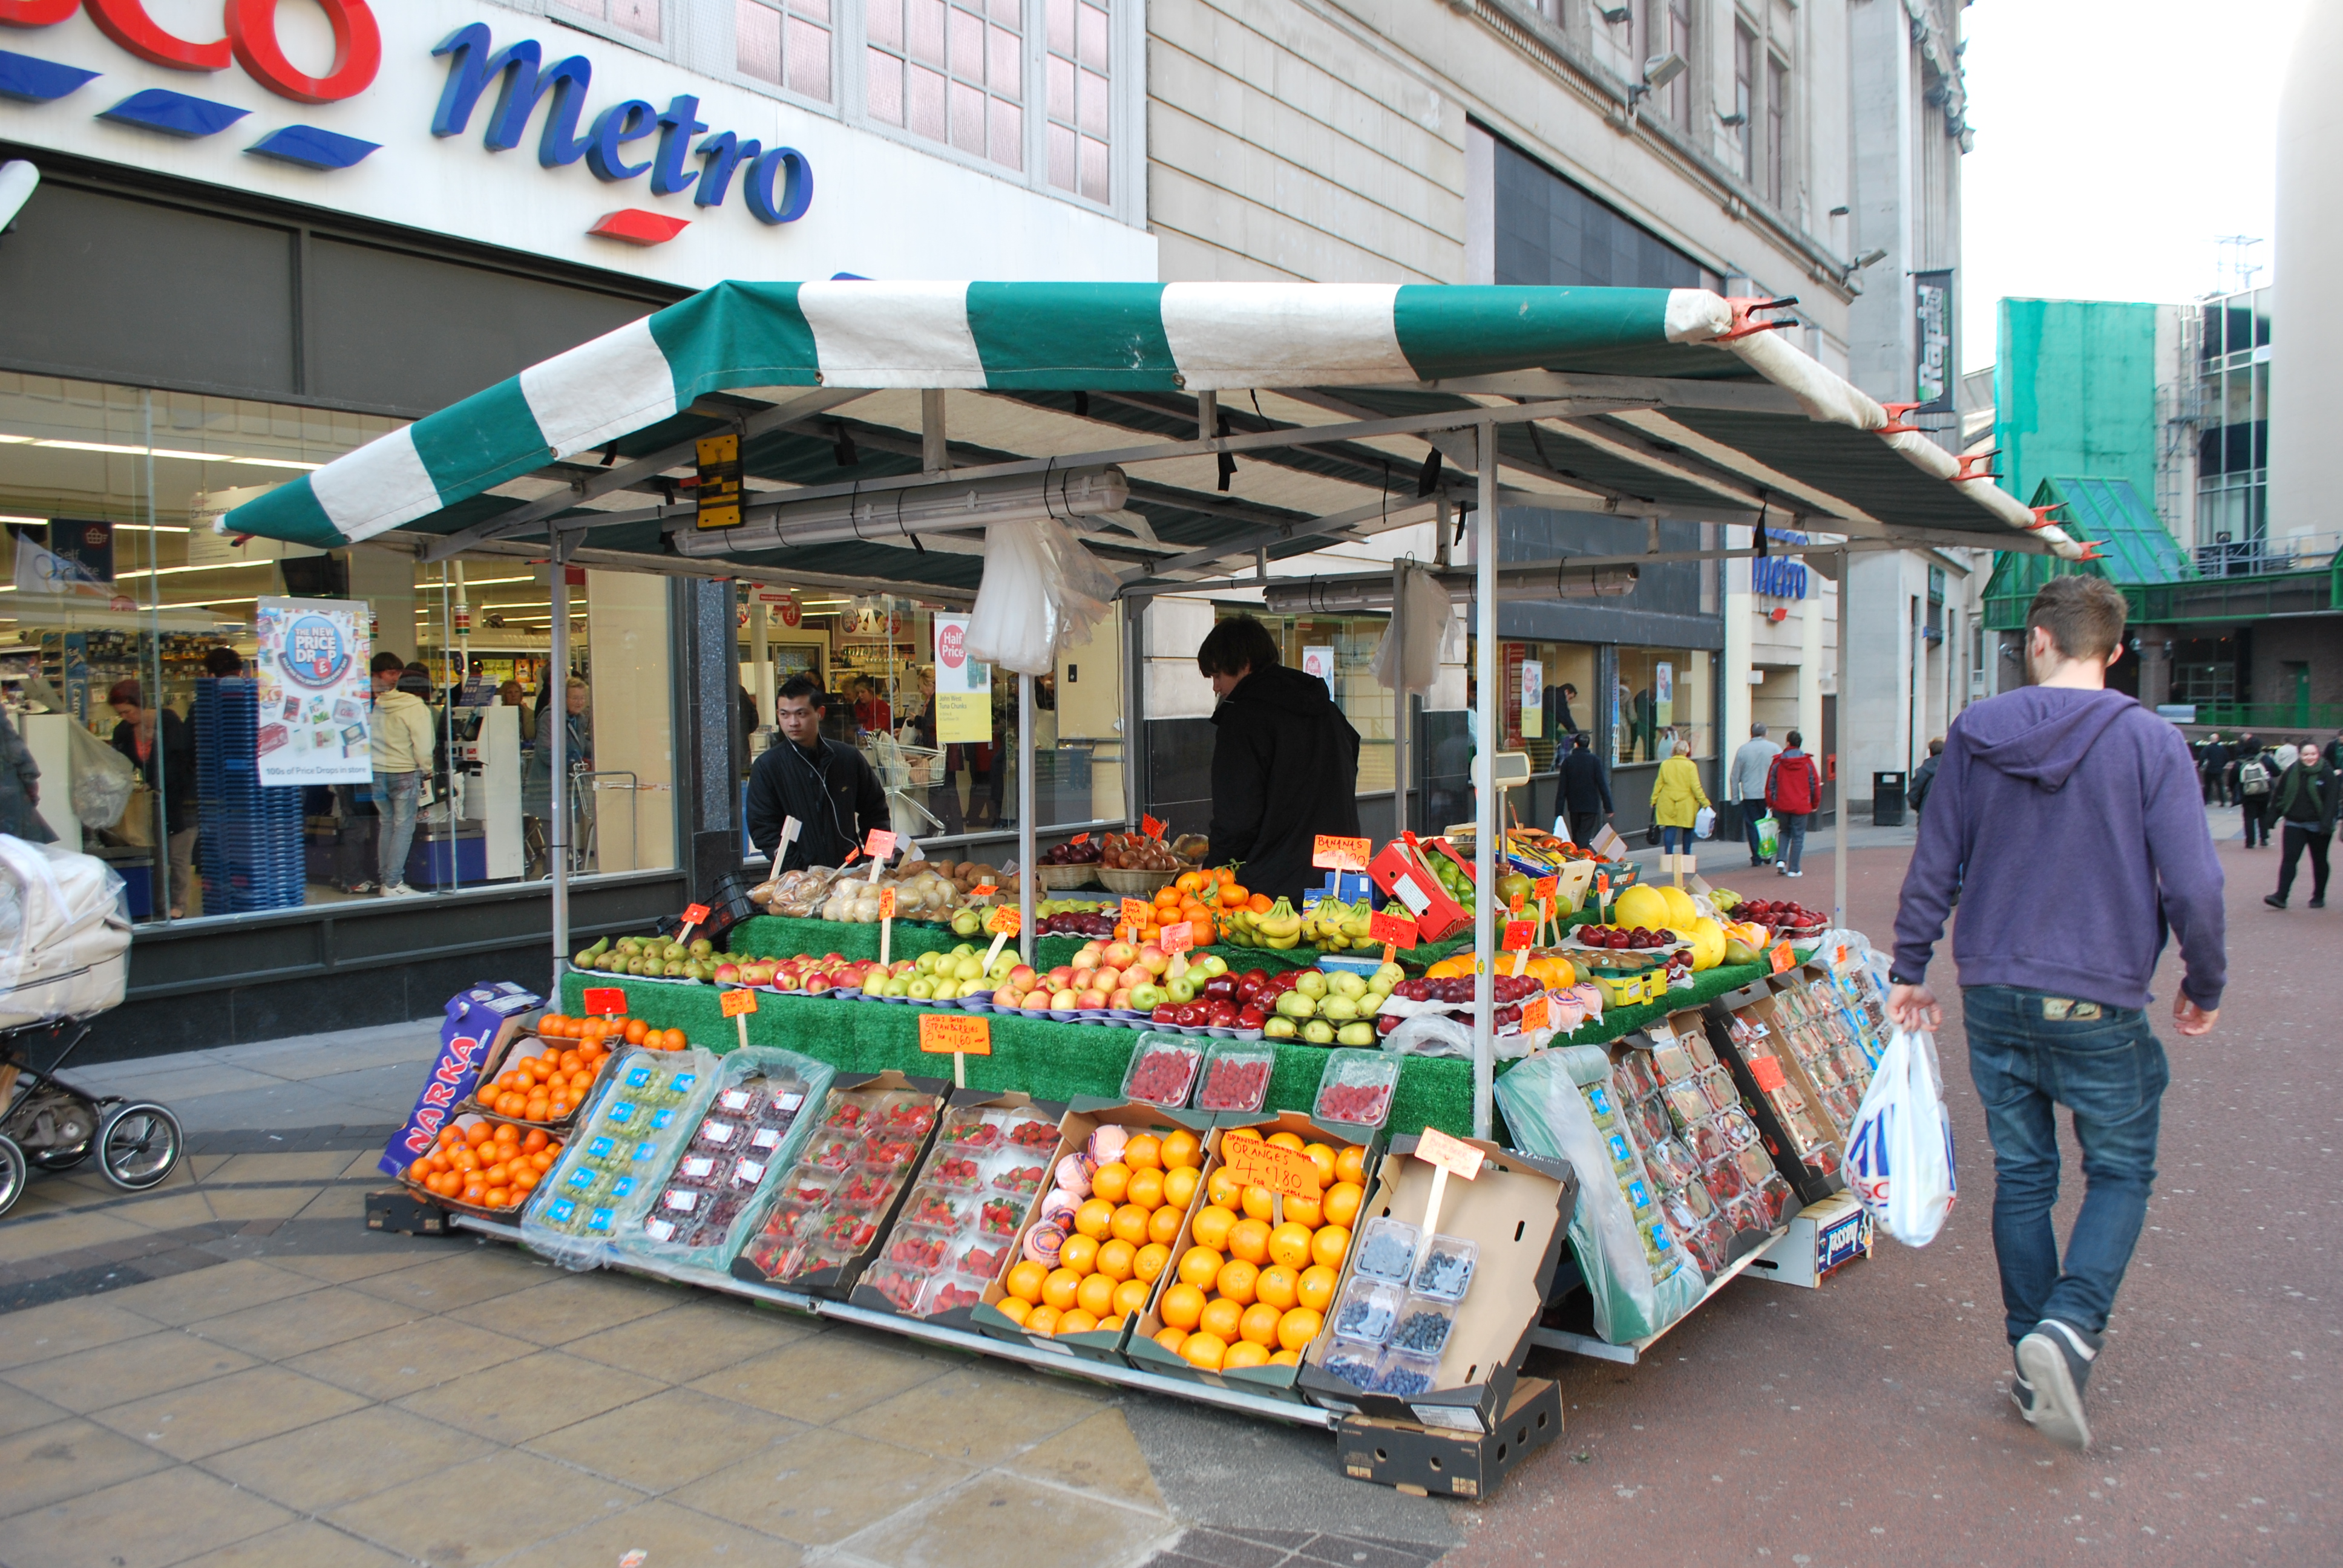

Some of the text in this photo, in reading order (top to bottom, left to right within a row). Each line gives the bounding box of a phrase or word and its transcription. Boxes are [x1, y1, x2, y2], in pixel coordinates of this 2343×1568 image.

[431, 22, 814, 226] Metro
[56, 547, 80, 560] Self
[311, 627, 335, 636] NEW
[295, 636, 336, 650] PRICE
[943, 632, 962, 645] Half
[942, 644, 964, 658] Price
[1308, 661, 1319, 670] Half
[316, 766, 338, 775] Drops
[1318, 837, 1363, 851] BANANAS
[1317, 850, 1329, 864] 2
[1124, 899, 1141, 908] ROYAL
[1000, 907, 1021, 919] GOLDEN
[1122, 912, 1129, 924] 2
[990, 918, 1000, 928] 2
[1381, 919, 1398, 929] PEARS
[1371, 924, 1379, 936] 2
[1507, 932, 1515, 941] 5
[1164, 939, 1170, 949] 2
[925, 1033, 934, 1047] 2
[405, 1036, 478, 1154] NARKA
[1227, 1134, 1259, 1146] SPANISH
[1263, 1141, 1293, 1154] SEEDLESS
[1233, 1142, 1289, 1165] ORANGES
[1236, 1159, 1257, 1180] 4
[1253, 1178, 1265, 1187] FOR
